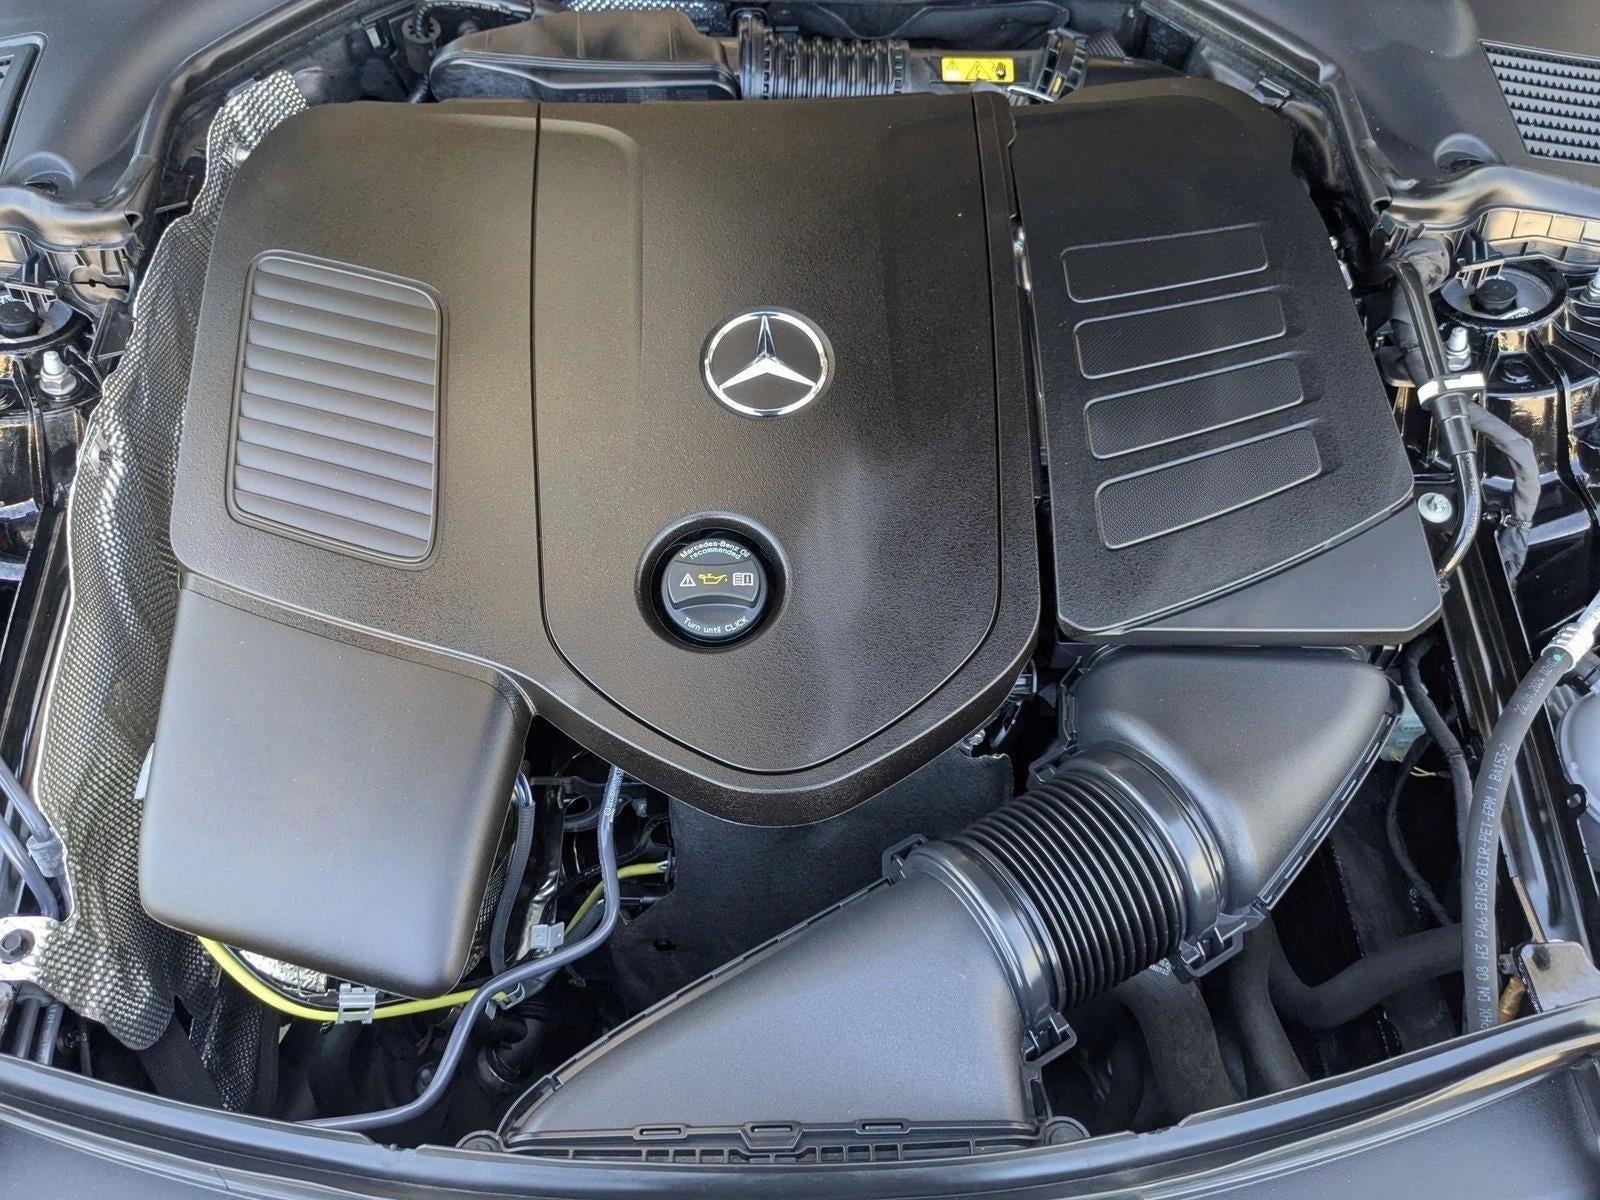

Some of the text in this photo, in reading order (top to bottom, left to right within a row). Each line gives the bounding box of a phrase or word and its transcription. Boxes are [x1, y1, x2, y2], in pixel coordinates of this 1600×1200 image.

[680, 540, 751, 558] Mercedes-Benz Oil
[690, 547, 742, 560] recommended
[684, 616, 749, 634] Turn until CLICK
[1475, 944, 1489, 959] H3
[1478, 986, 1491, 1001] DN
